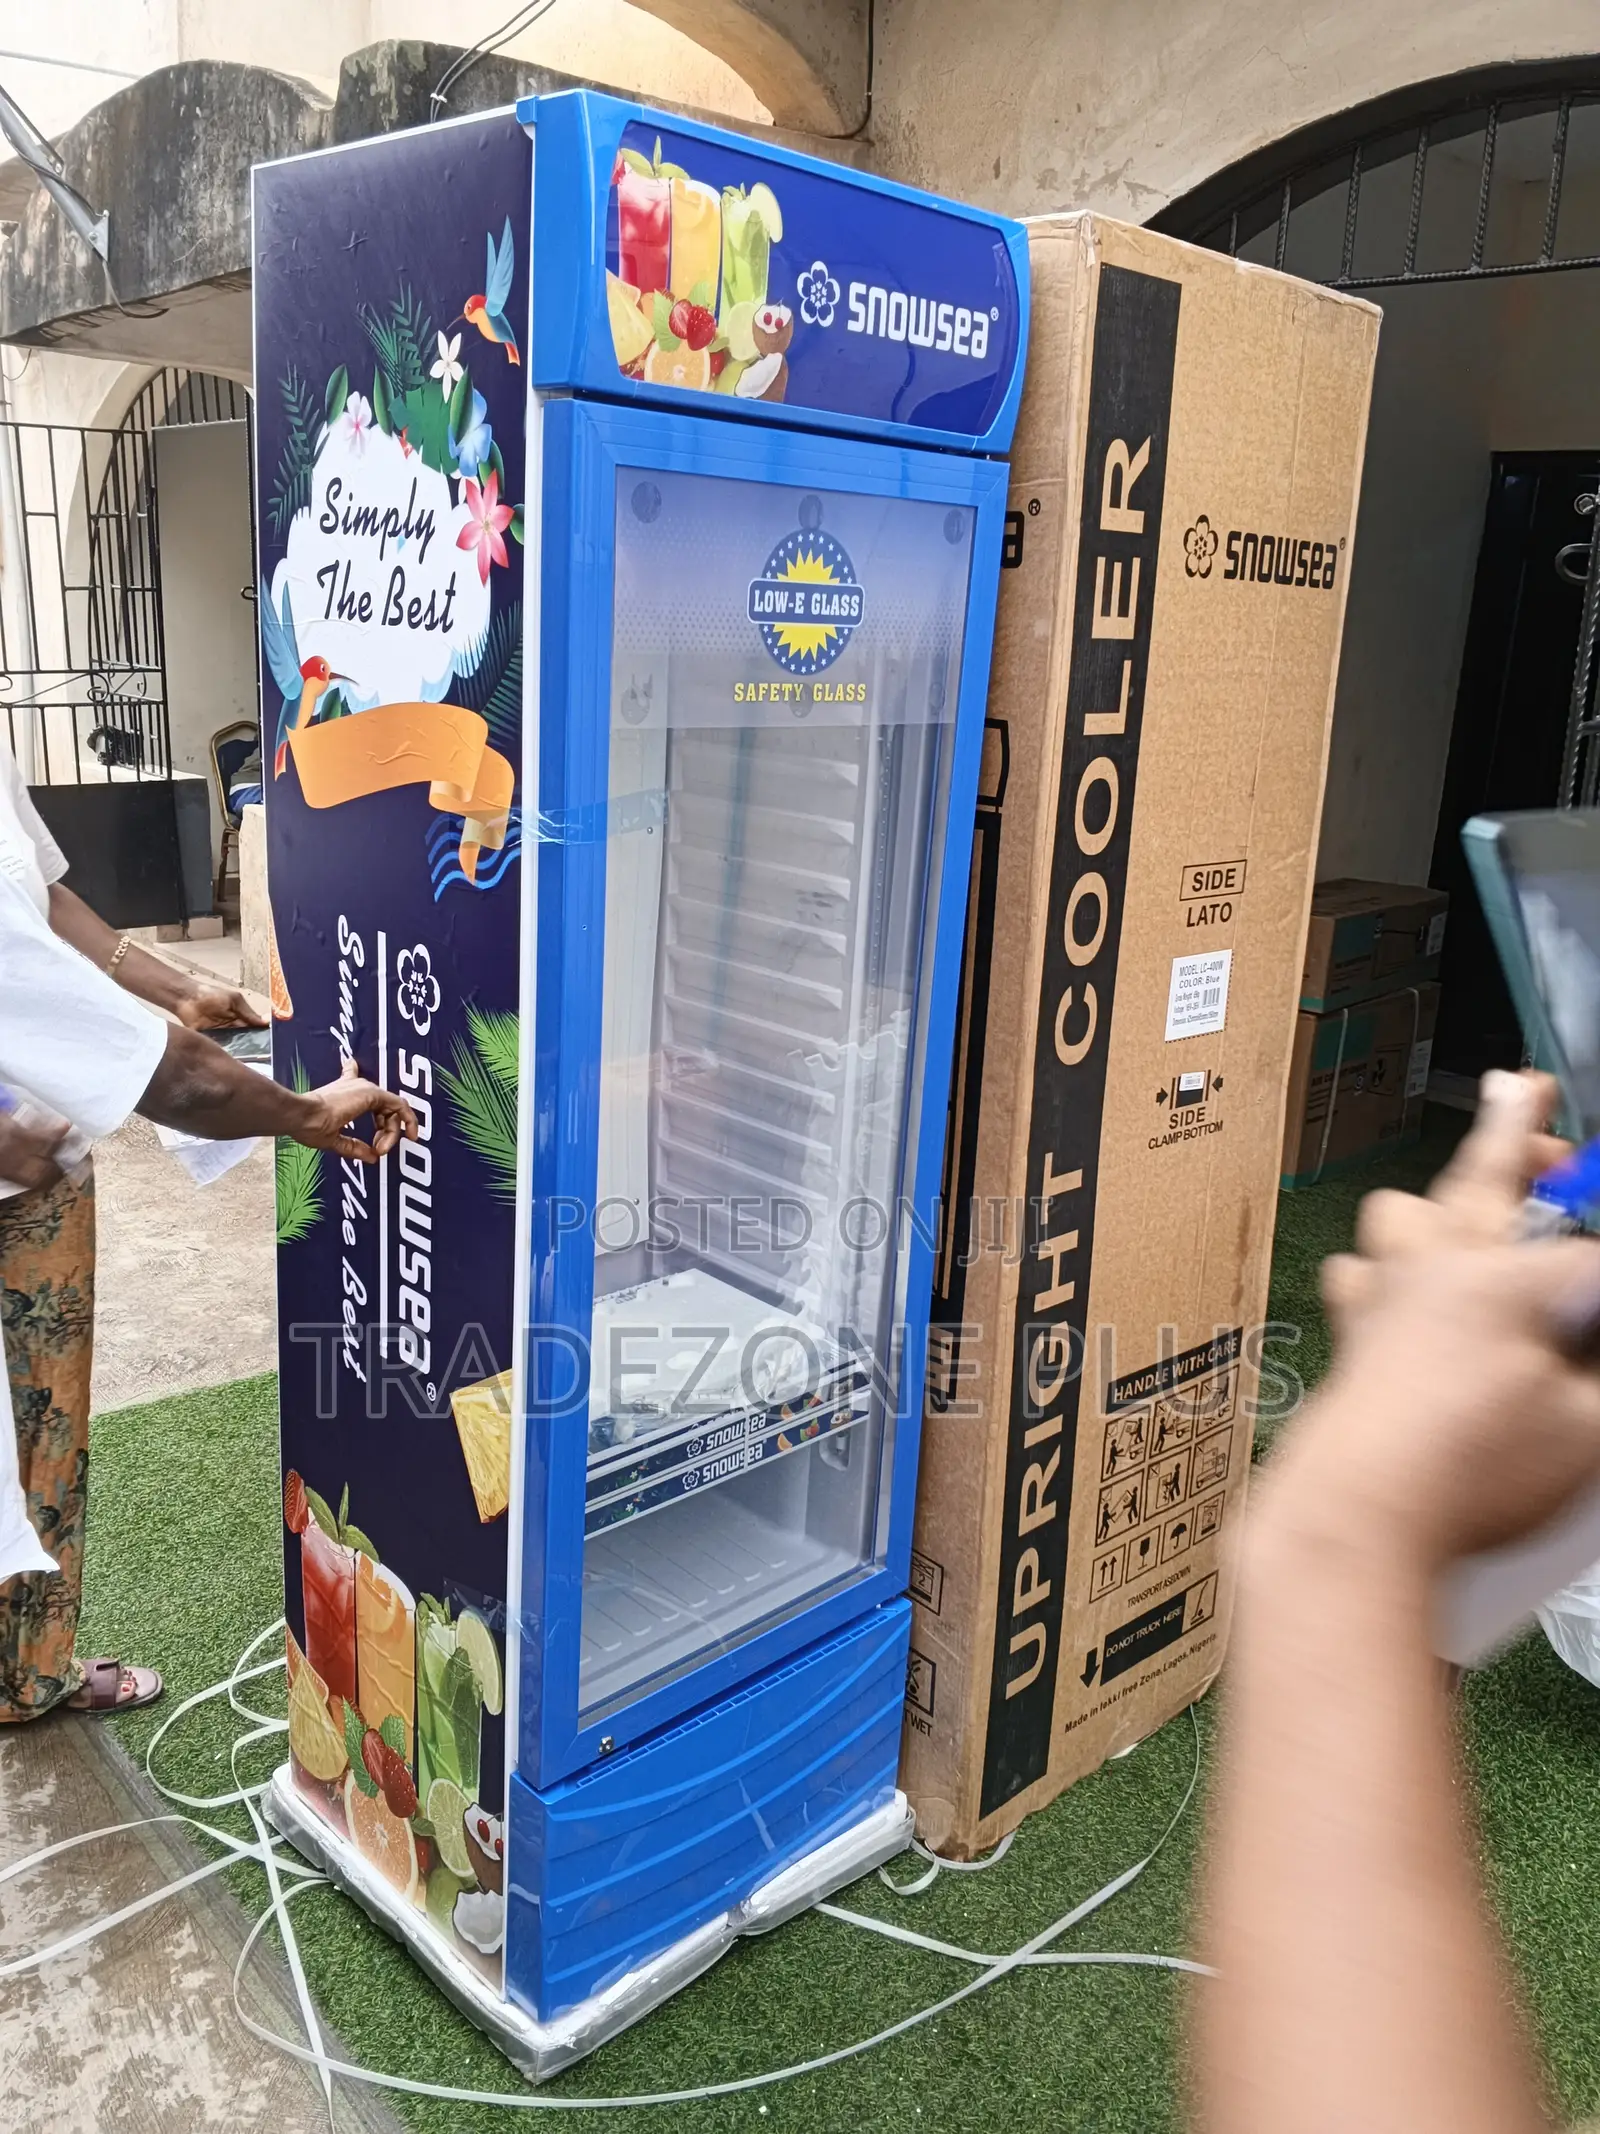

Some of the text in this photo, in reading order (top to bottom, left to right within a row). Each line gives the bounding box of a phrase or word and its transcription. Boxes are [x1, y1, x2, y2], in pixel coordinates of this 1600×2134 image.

[319, 476, 435, 565] Simply
[316, 559, 456, 633] The Best
[754, 589, 860, 617] LOW-E GLASS
[734, 682, 867, 702] SAFETY GLASS
[1192, 868, 1236, 893] SIDE
[1186, 901, 1232, 928] LATO
[1006, 435, 1151, 1700] UPRIGHT COOLER
[1169, 1107, 1206, 1130] SIDE
[330, 914, 368, 1383] Simp The Best
[1148, 1120, 1223, 1150] CLAMP BOTTOM
[1114, 1337, 1238, 1403] HANDLE WITH CARE
[706, 1413, 767, 1450] snowea
[918, 1574, 925, 1587] 2
[1106, 1605, 1183, 1657] DO NOT TRUCK HERE
[910, 1713, 933, 1737] WET
[1065, 1713, 1088, 1733] Made
[1090, 1707, 1098, 1718] in
